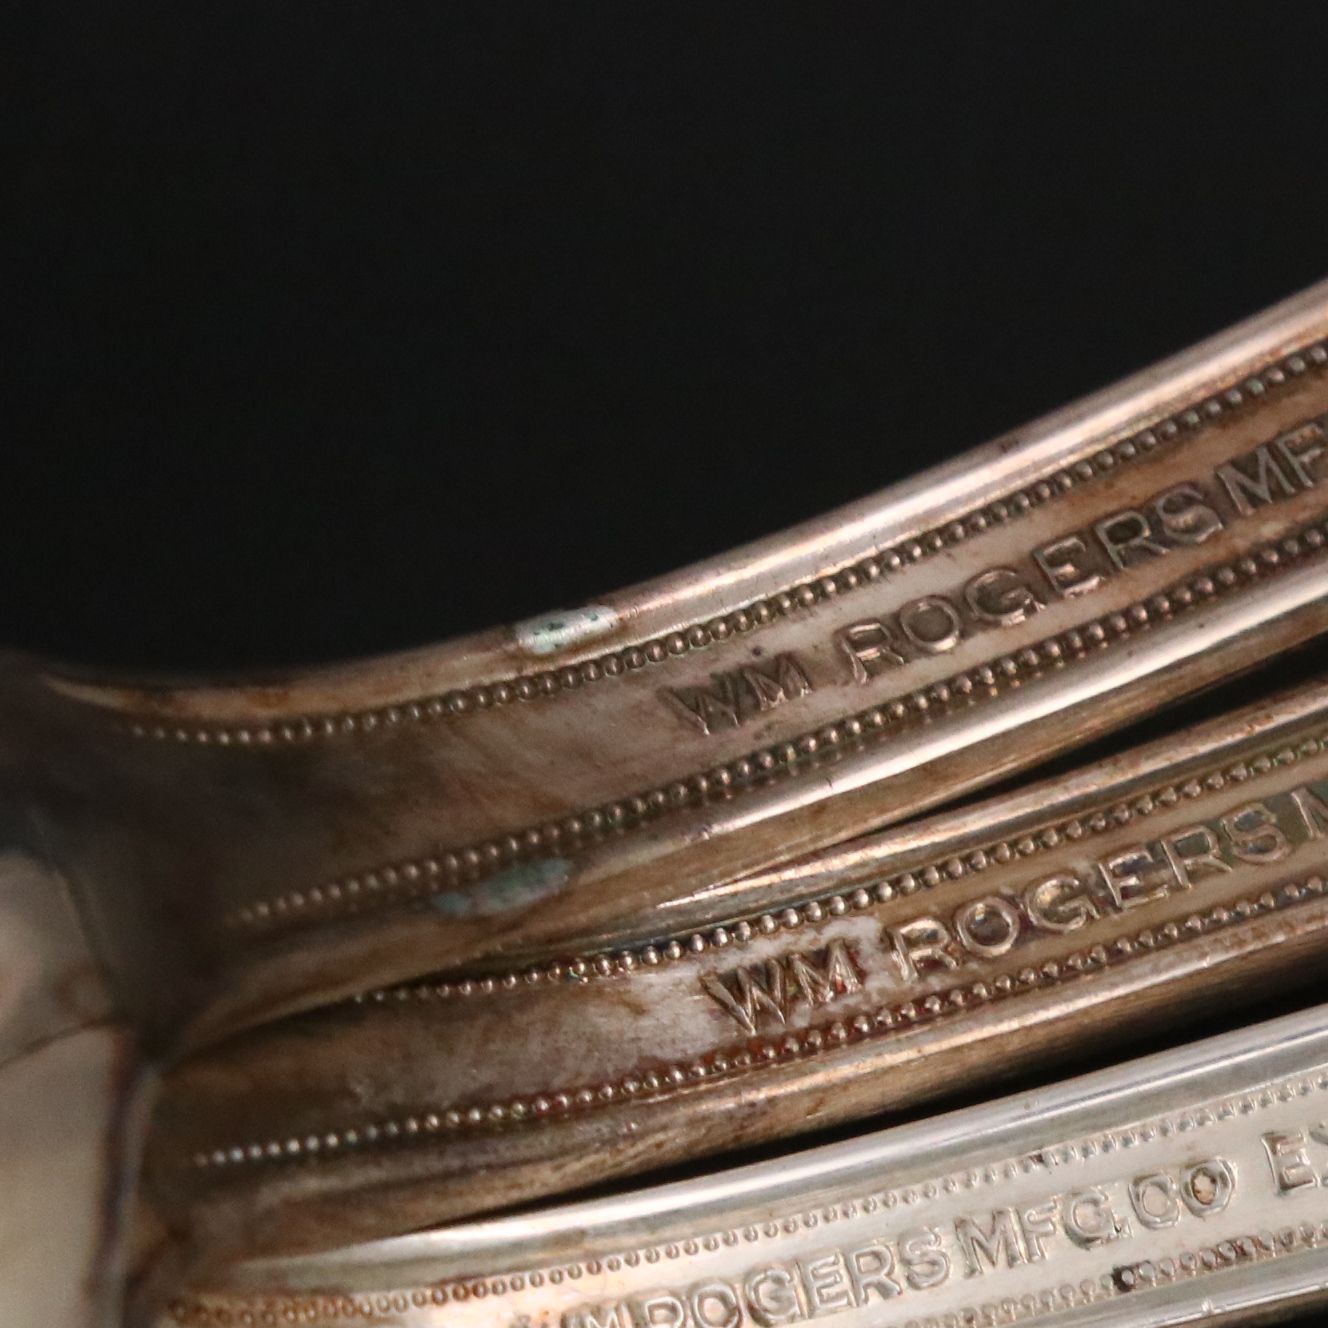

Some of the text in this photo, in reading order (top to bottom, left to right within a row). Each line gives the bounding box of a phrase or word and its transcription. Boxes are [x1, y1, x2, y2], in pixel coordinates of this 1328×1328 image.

[661, 653, 813, 738] WM
[833, 485, 1226, 686] ROGERS
[702, 938, 864, 1036] WM
[883, 803, 1294, 983] ROGERS
